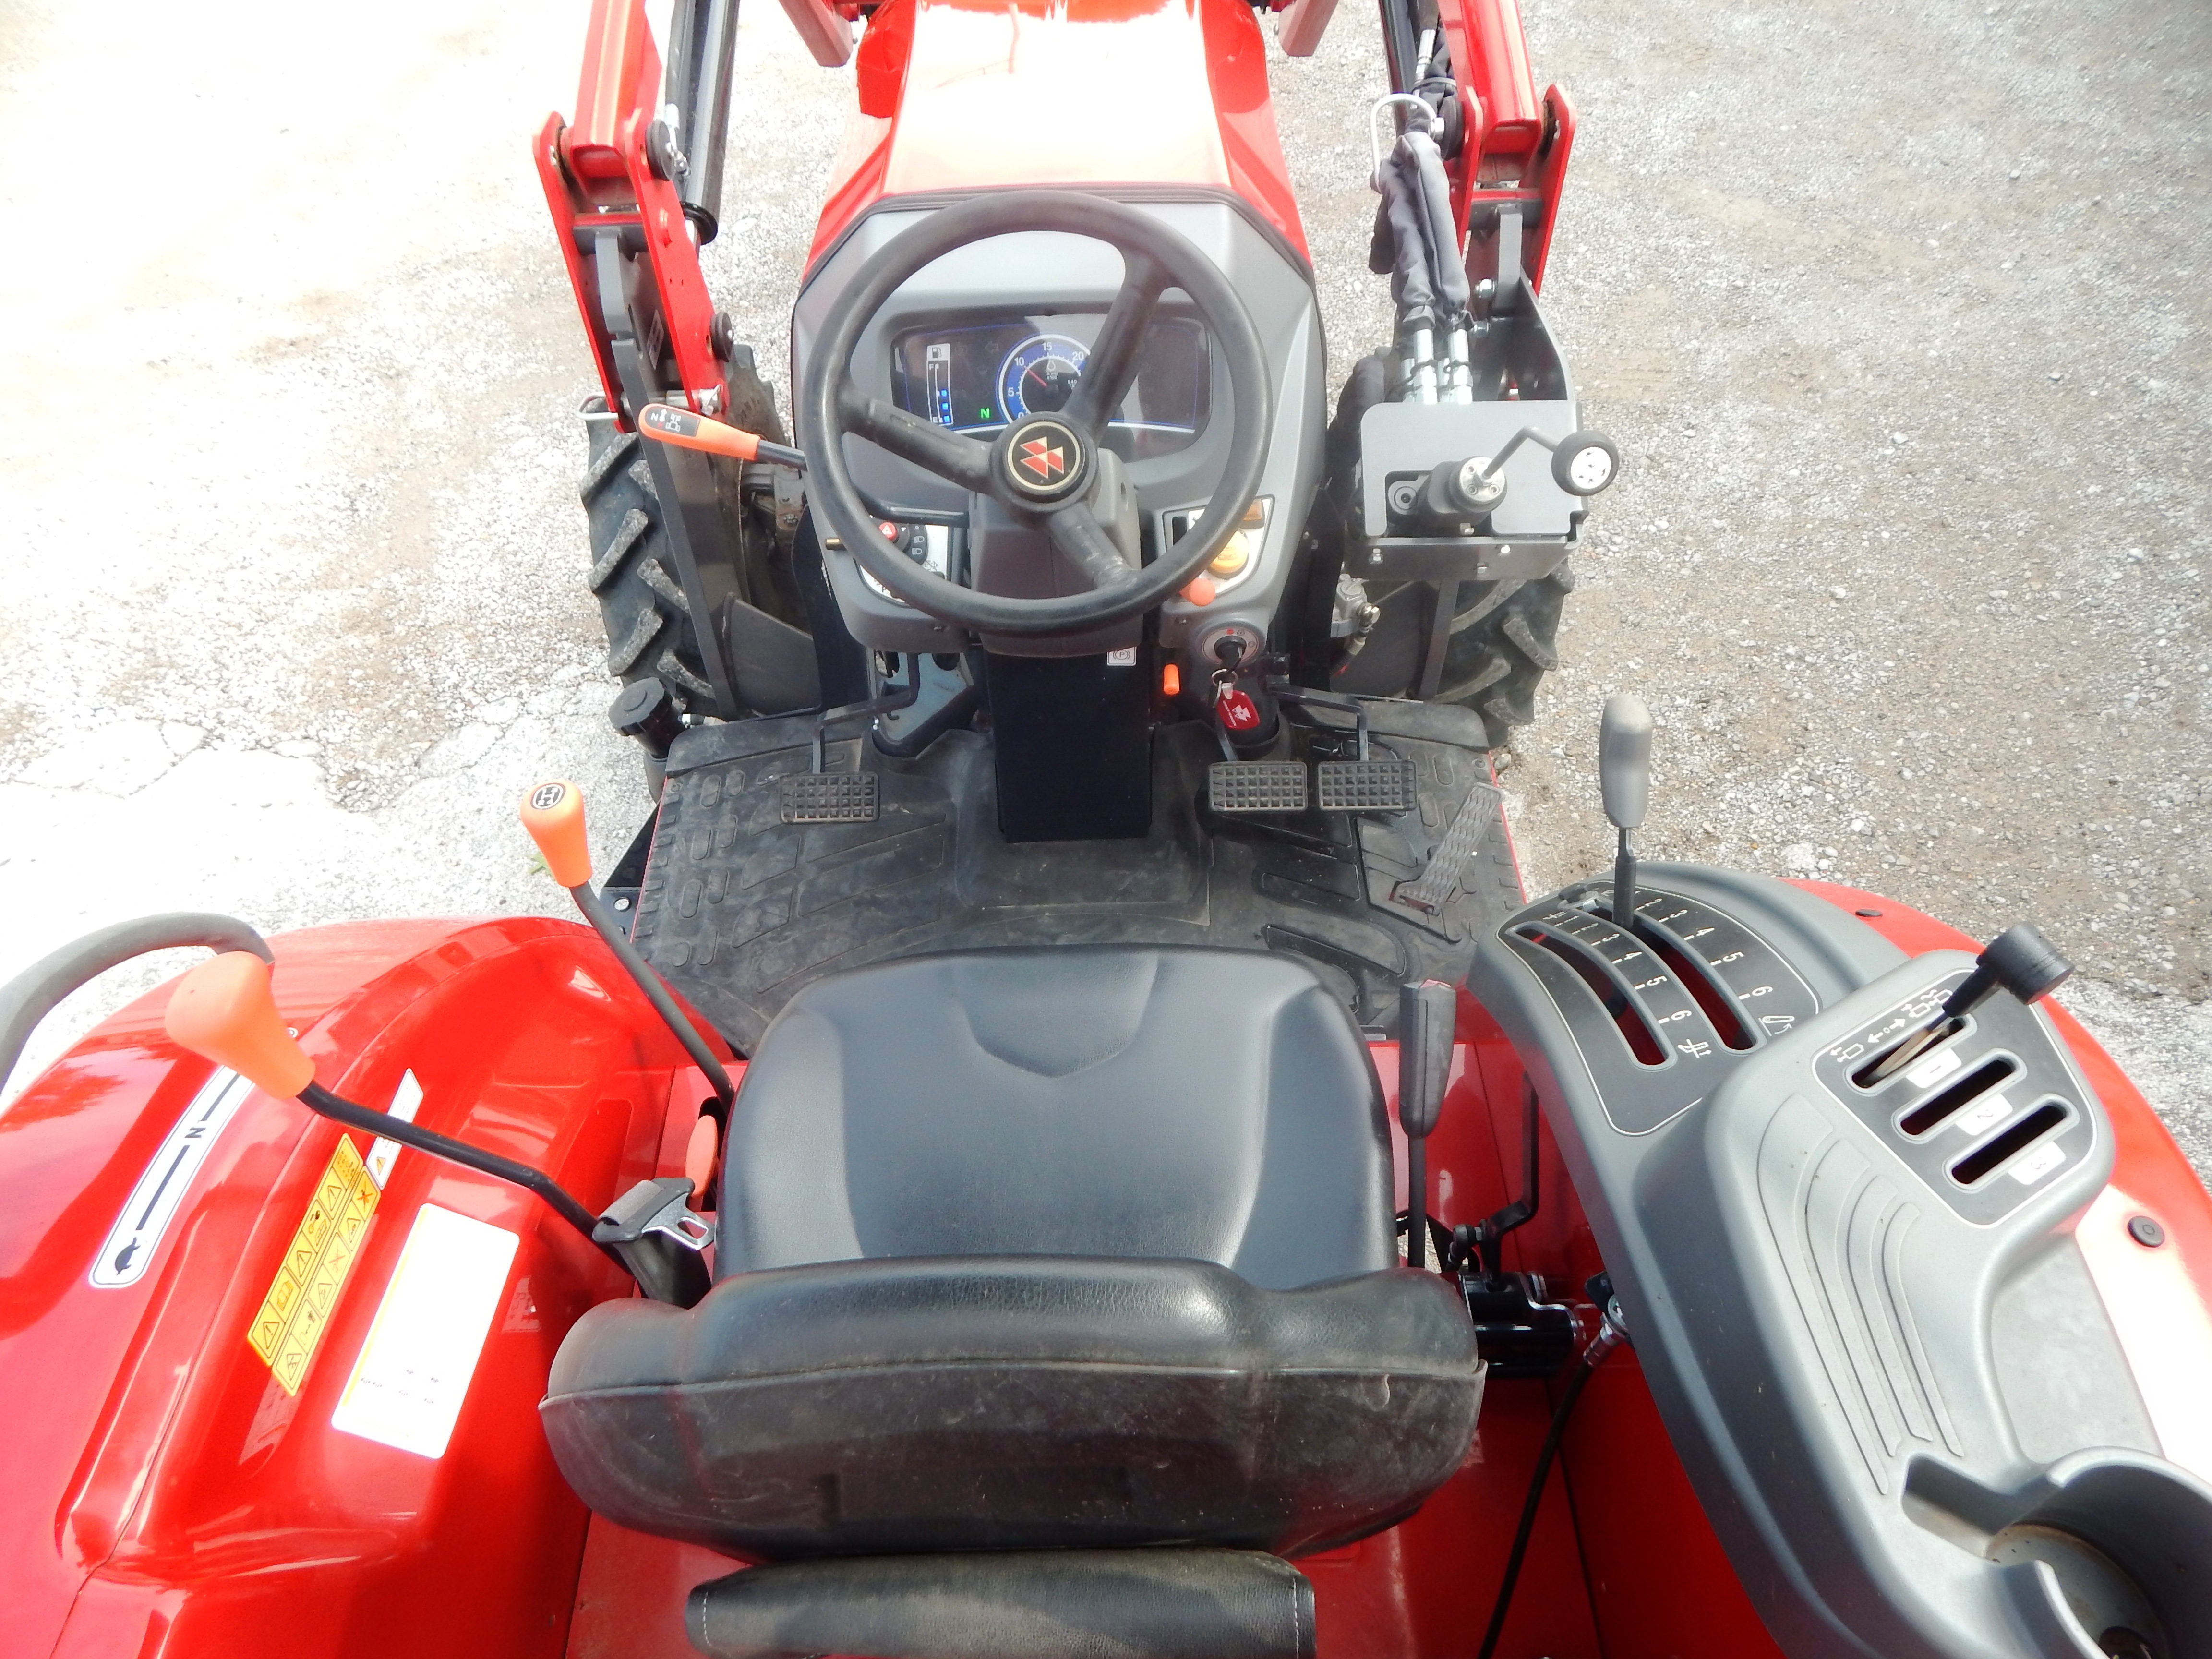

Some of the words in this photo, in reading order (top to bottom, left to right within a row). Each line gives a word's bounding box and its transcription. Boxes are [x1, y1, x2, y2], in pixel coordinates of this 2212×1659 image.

[1042, 342, 1052, 351] 15
[1072, 351, 1084, 360] 20
[1014, 357, 1025, 366] 10
[1008, 387, 1015, 397] 5
[650, 412, 659, 421] N
[980, 408, 990, 418] N
[1644, 898, 1662, 907] 2
[1670, 909, 1688, 918] 3
[1581, 923, 1599, 931] 2
[1696, 927, 1715, 936] 4
[1602, 933, 1620, 942] 3
[1624, 951, 1643, 960] 4
[1722, 951, 1744, 962] 5
[1647, 975, 1667, 986] 5
[1752, 986, 1773, 996] 6
[1671, 1010, 1692, 1020] 6
[1976, 1109, 1994, 1121] 2
[184, 1127, 206, 1139] N
[2030, 1157, 2046, 1170] 3
